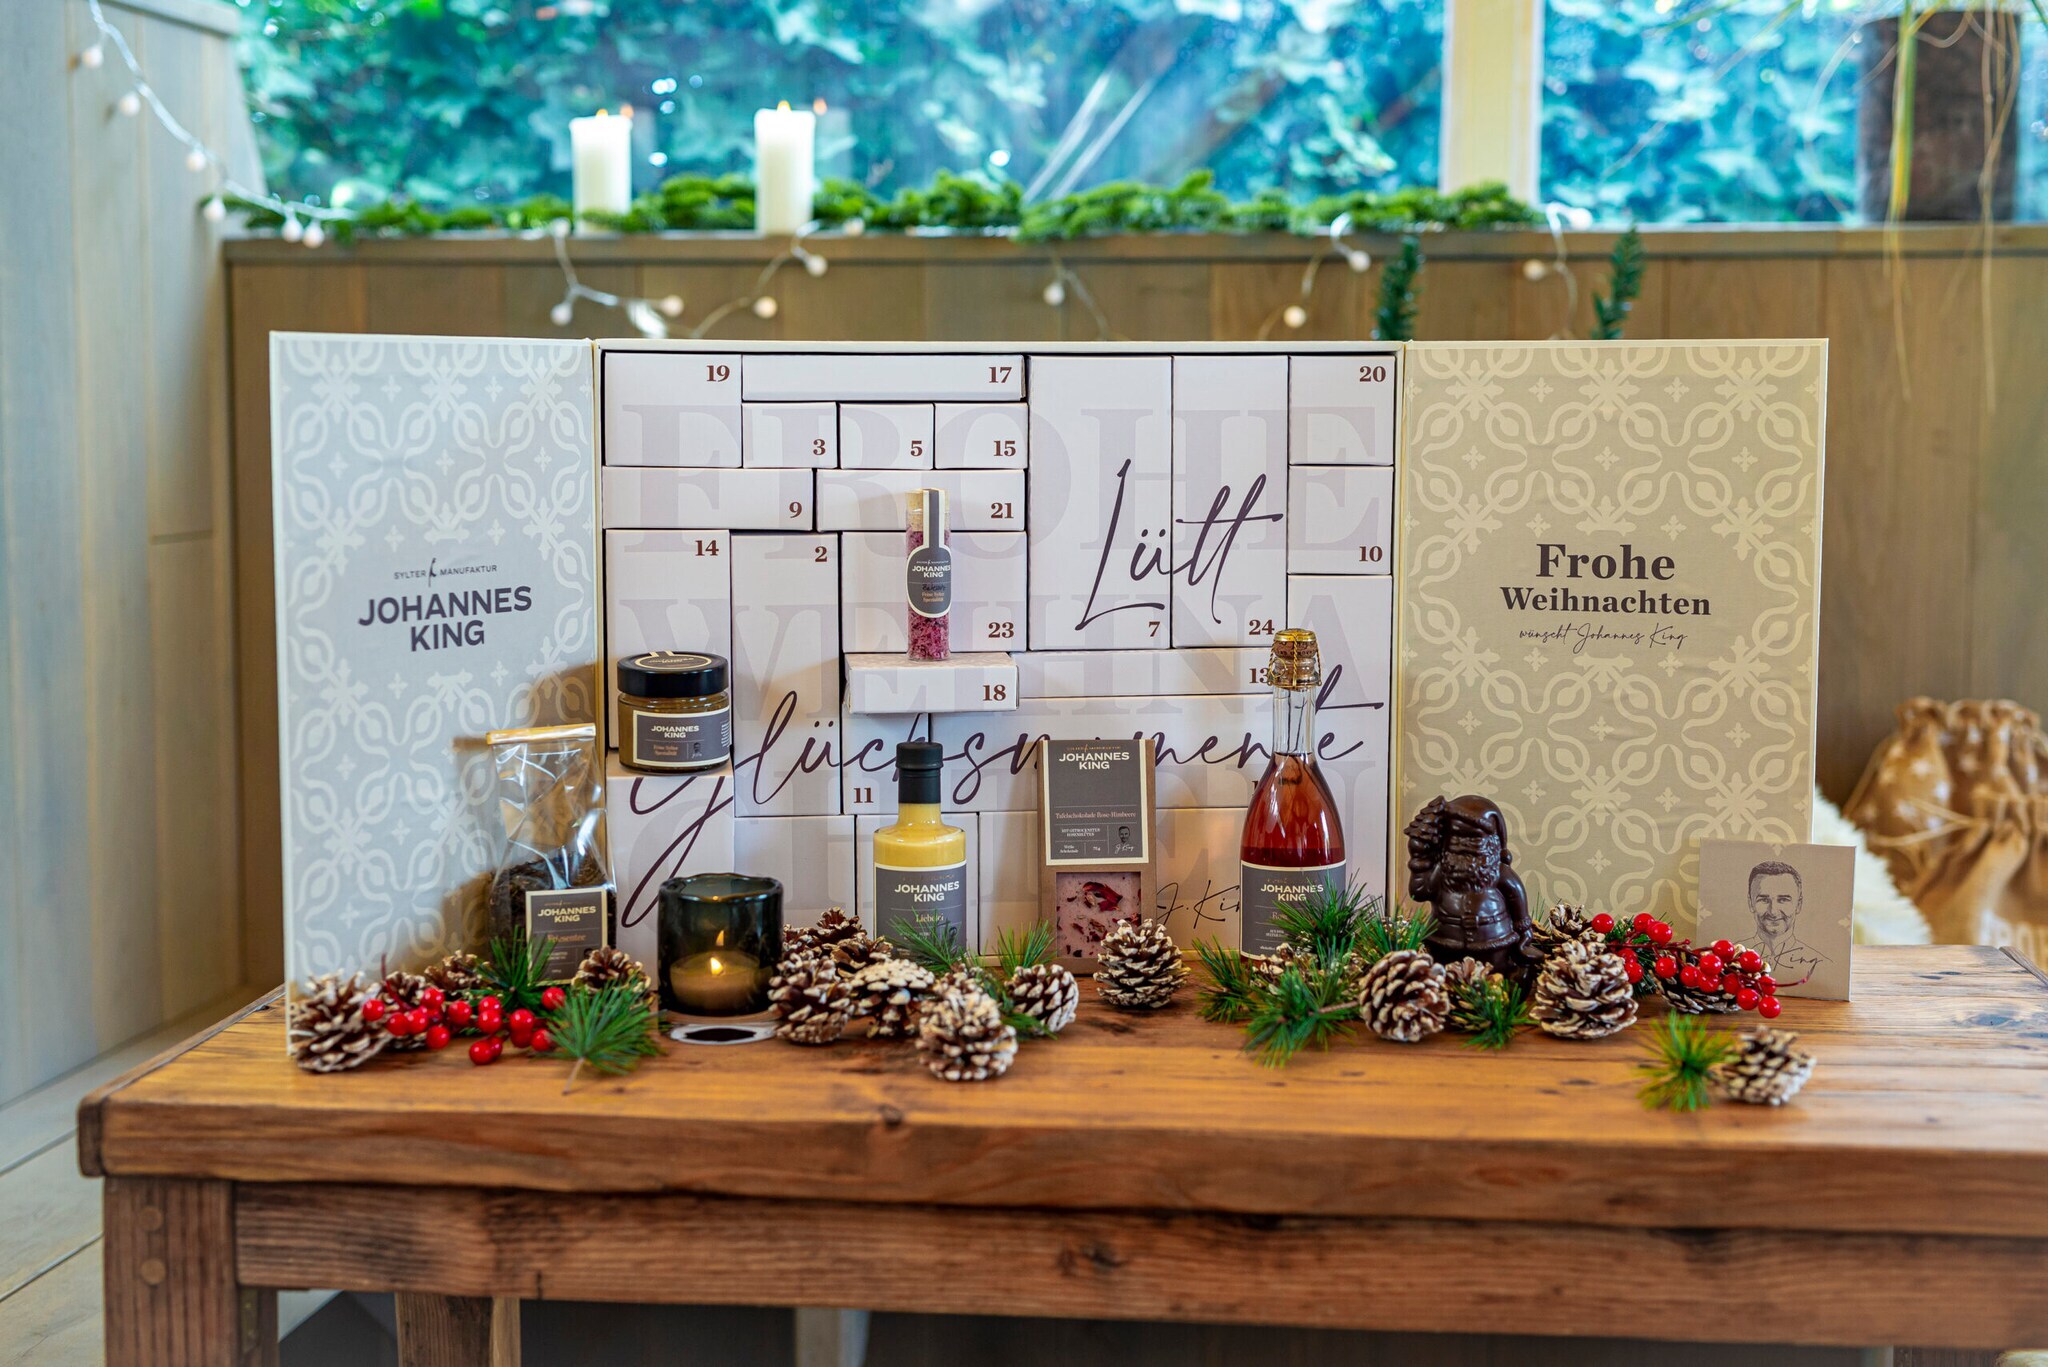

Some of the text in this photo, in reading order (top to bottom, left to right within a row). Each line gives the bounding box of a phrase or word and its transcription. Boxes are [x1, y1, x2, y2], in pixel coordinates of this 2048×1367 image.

[706, 364, 731, 383] 19
[987, 366, 1013, 384] 17
[1358, 365, 1387, 383] 20
[812, 438, 826, 456] 3
[910, 439, 923, 457] 5
[993, 440, 1017, 457] 15
[788, 501, 803, 519] 9
[990, 502, 1014, 519] 21
[694, 539, 720, 557] 14
[1074, 458, 1284, 632] Lütt
[1358, 545, 1383, 562] 10
[814, 545, 828, 563] 2
[1535, 543, 1676, 581] Frohe
[394, 564, 498, 580] SYLTER MANUFAKTUR
[358, 585, 533, 626] JOHANNES
[1500, 586, 1712, 616] Weihnachten
[410, 619, 486, 652] KING
[988, 621, 1015, 639] 23
[1148, 620, 1162, 638] 7
[1248, 619, 1275, 636] 24
[1519, 622, 1688, 654] wünscht Johannes King
[1249, 668, 1269, 684] 13
[982, 684, 1007, 702] 18
[650, 725, 700, 733] JOHANNES
[664, 731, 687, 739] KING
[1058, 752, 1130, 762] JOHANNES
[1079, 761, 1110, 770] KING
[853, 787, 874, 804] 11
[894, 881, 960, 894] JOHANNES
[1260, 883, 1325, 894] JOHANNES
[913, 892, 945, 903] KING
[1277, 893, 1307, 902] KING
[537, 905, 597, 917] JOHANNES
[554, 914, 581, 923] KING
